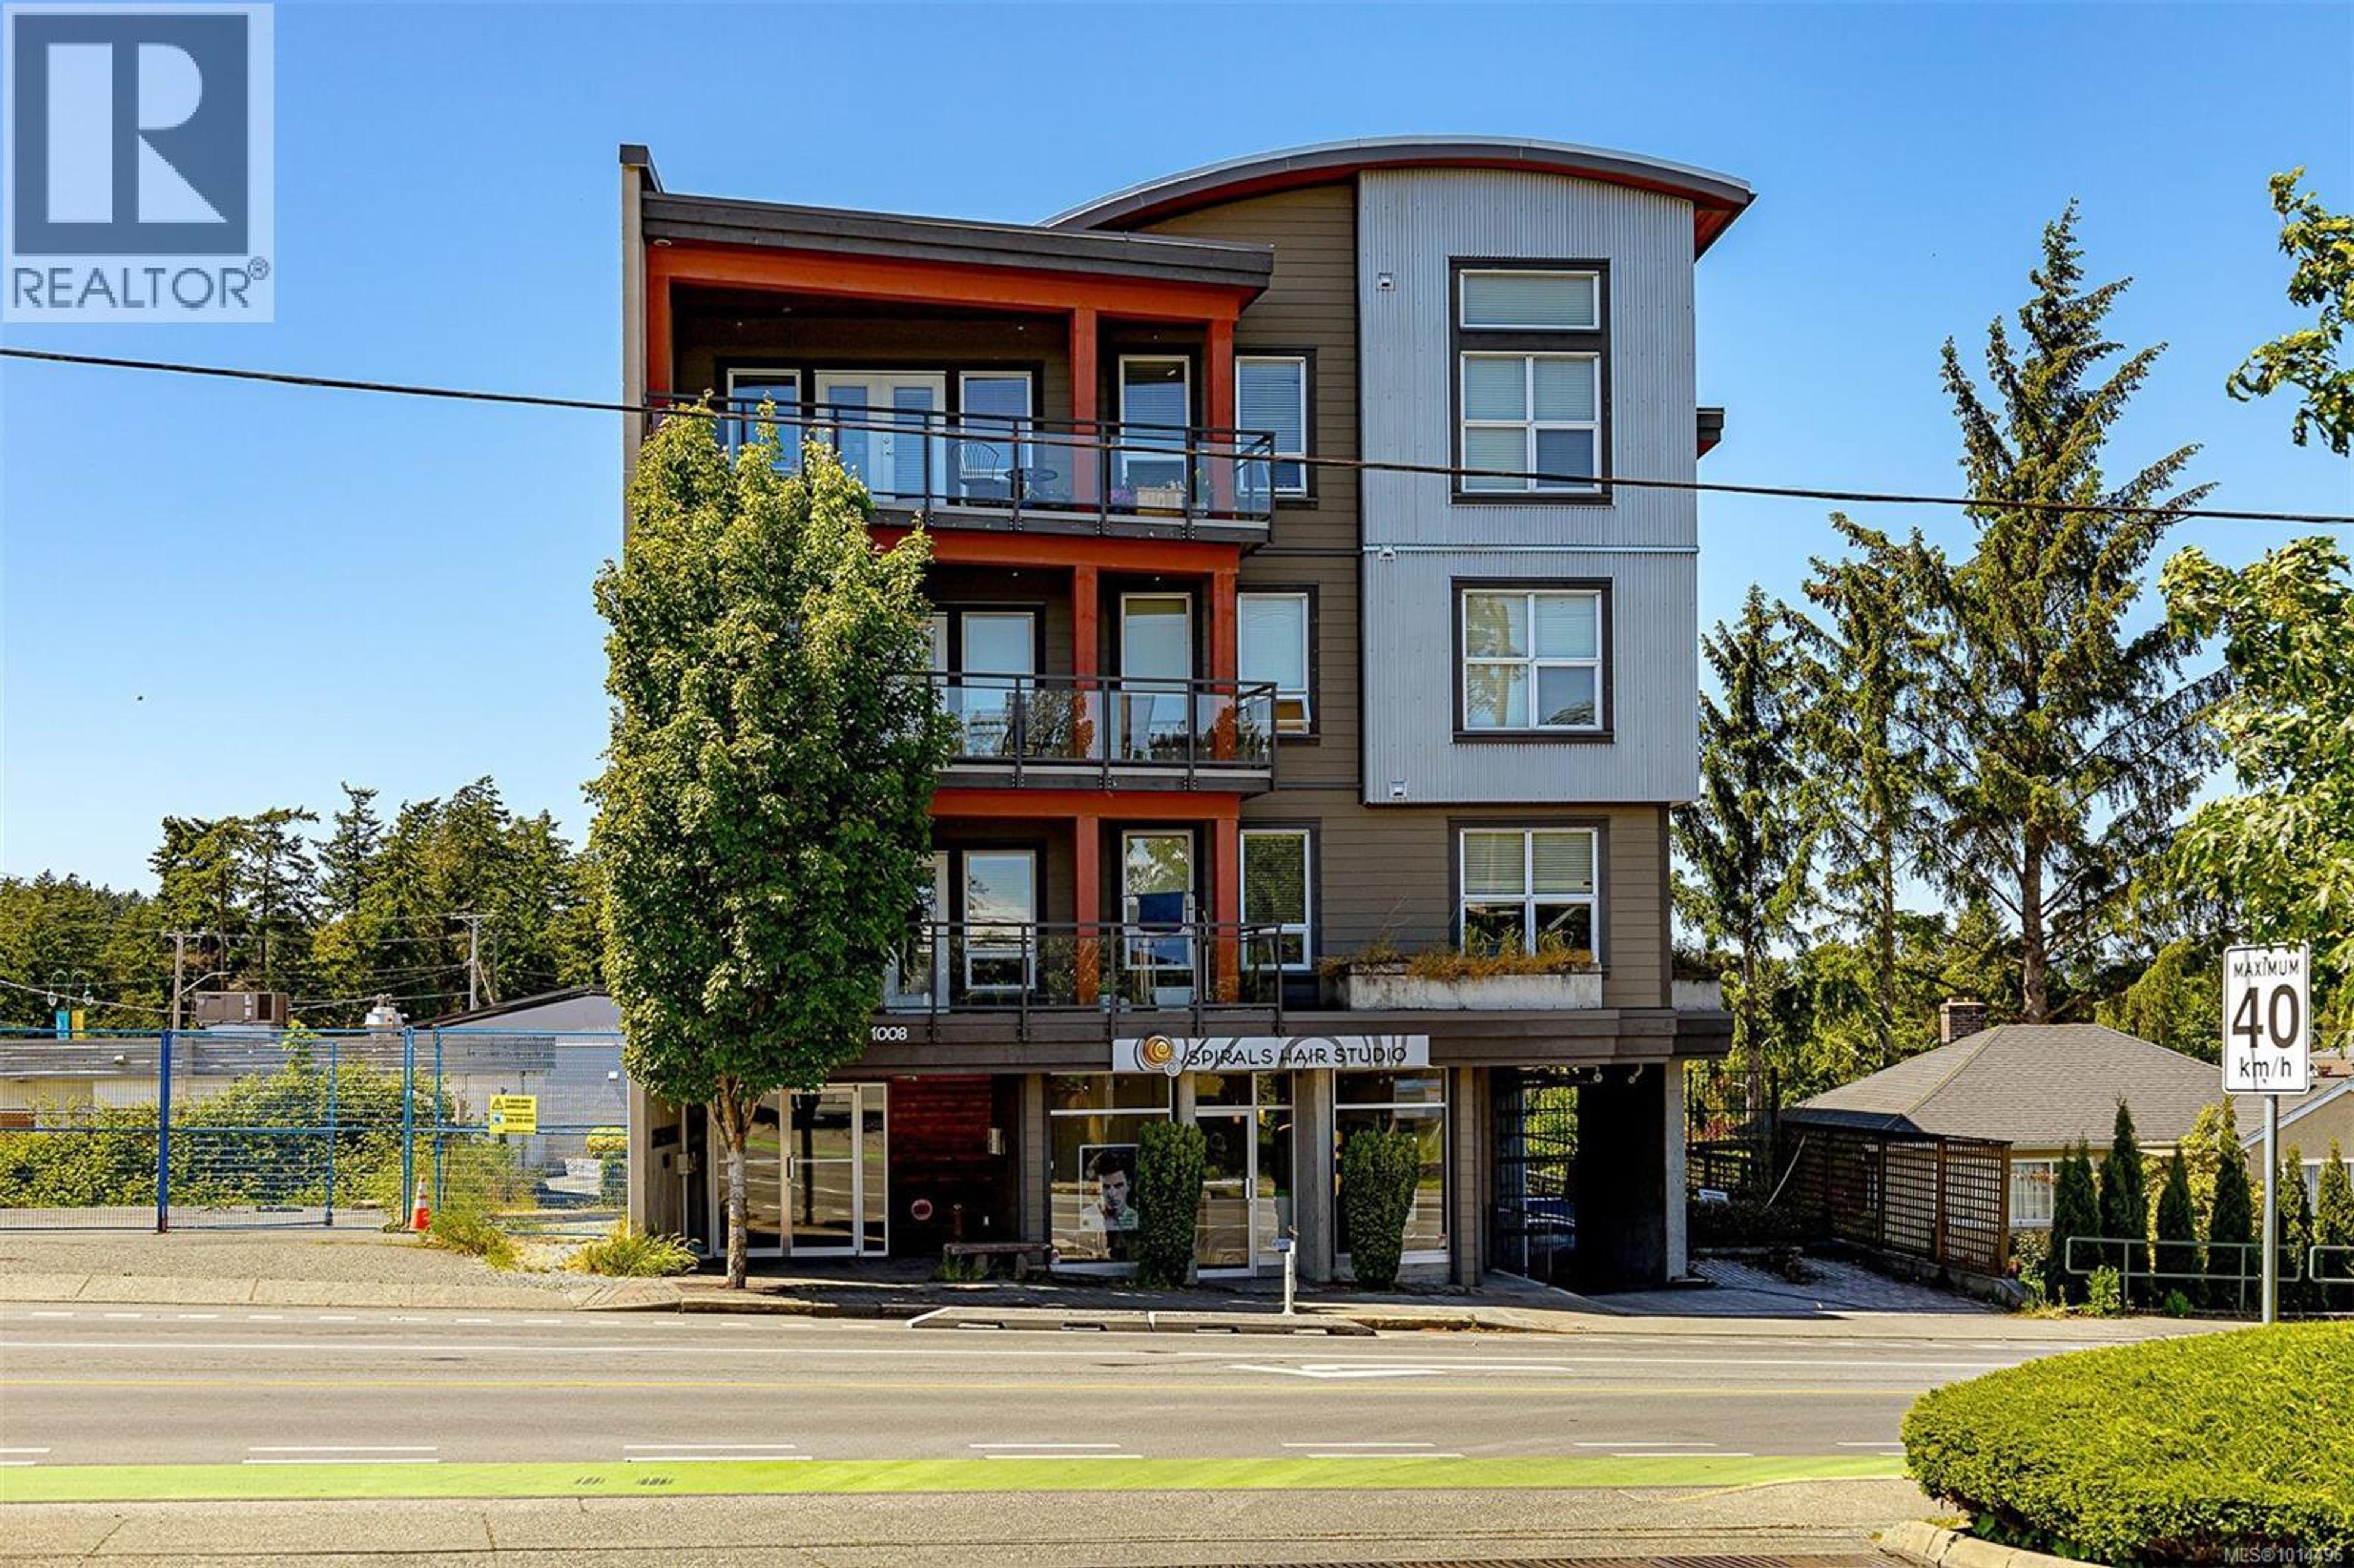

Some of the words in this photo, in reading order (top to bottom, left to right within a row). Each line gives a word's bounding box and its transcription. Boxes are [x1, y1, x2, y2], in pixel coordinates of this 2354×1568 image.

[2233, 959, 2299, 978] MAXIMUM
[2232, 984, 2299, 1049] 40
[870, 1026, 907, 1041] 1008
[1188, 1048, 1274, 1065] SPIRALS
[1279, 1048, 1328, 1064] HAIR
[1333, 1047, 1406, 1063] STUDIO
[2239, 1056, 2292, 1078] km/h
